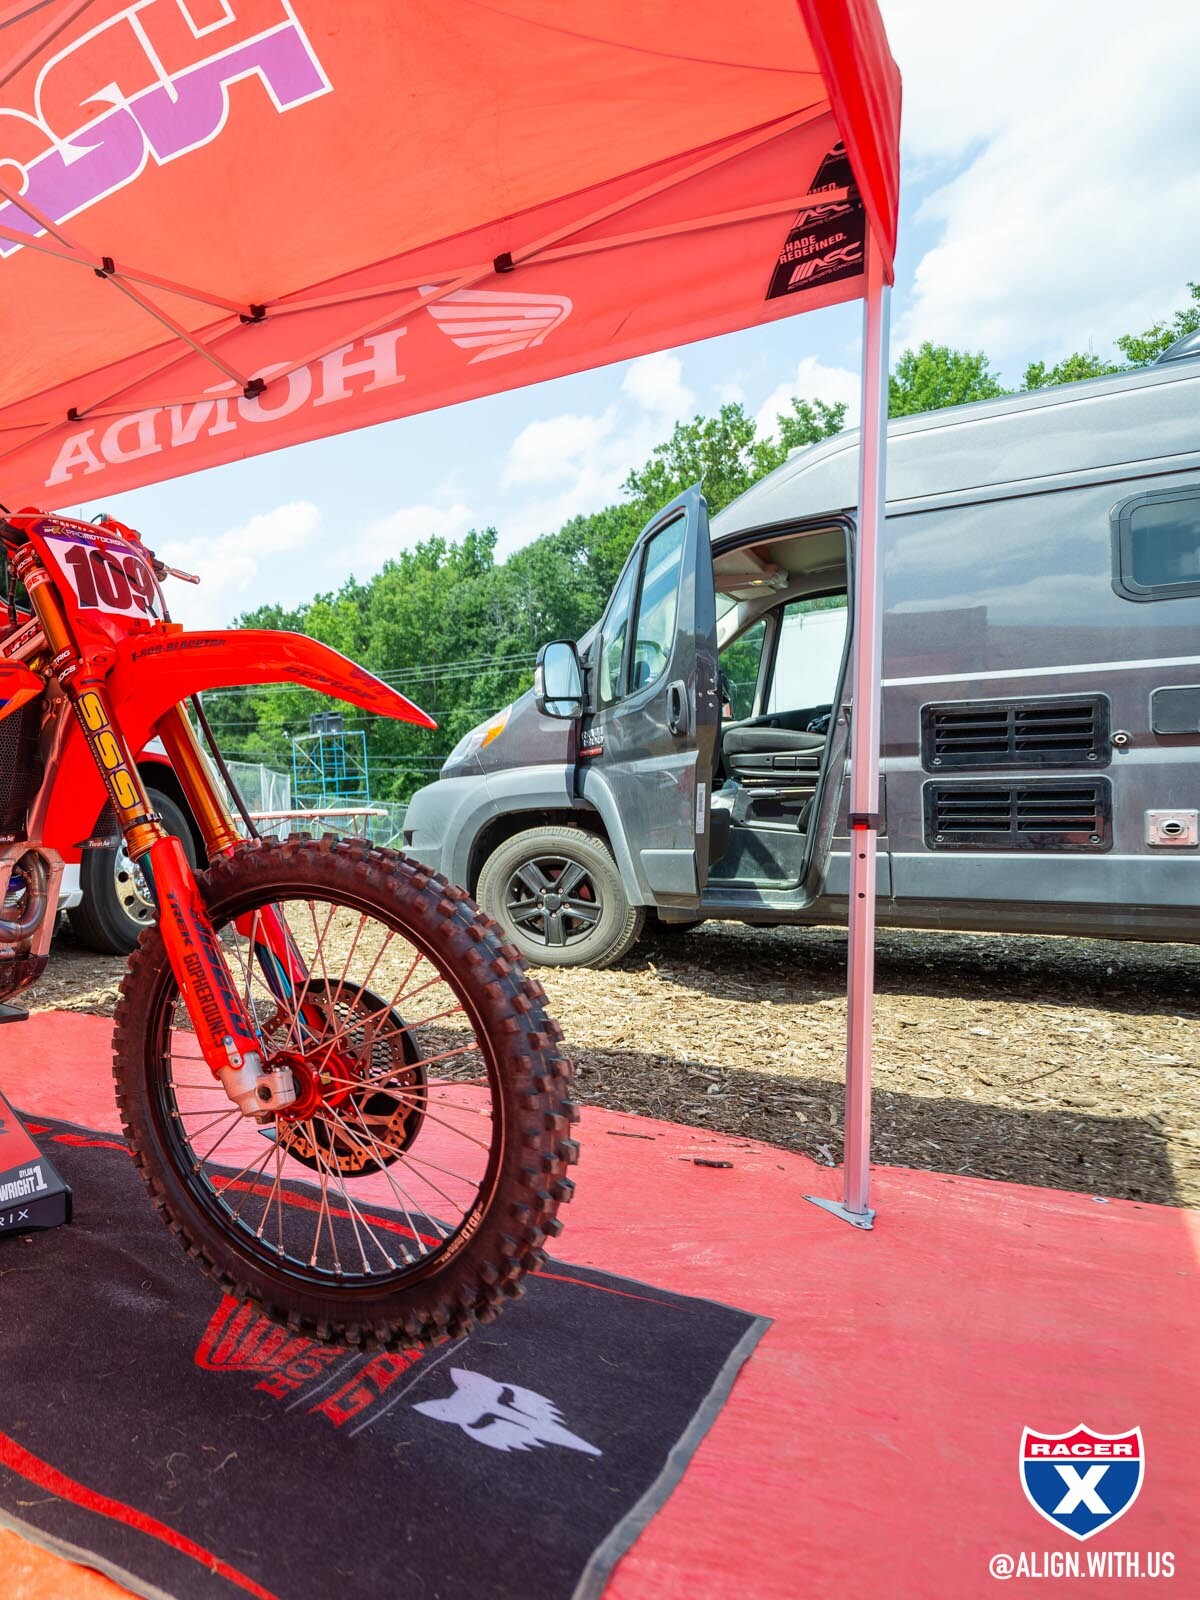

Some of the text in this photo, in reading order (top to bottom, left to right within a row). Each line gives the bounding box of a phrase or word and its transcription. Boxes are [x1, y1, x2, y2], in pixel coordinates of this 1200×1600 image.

[65, 545, 155, 614] 109
[77, 691, 143, 811] SSS
[34, 1165, 48, 1191] 1
